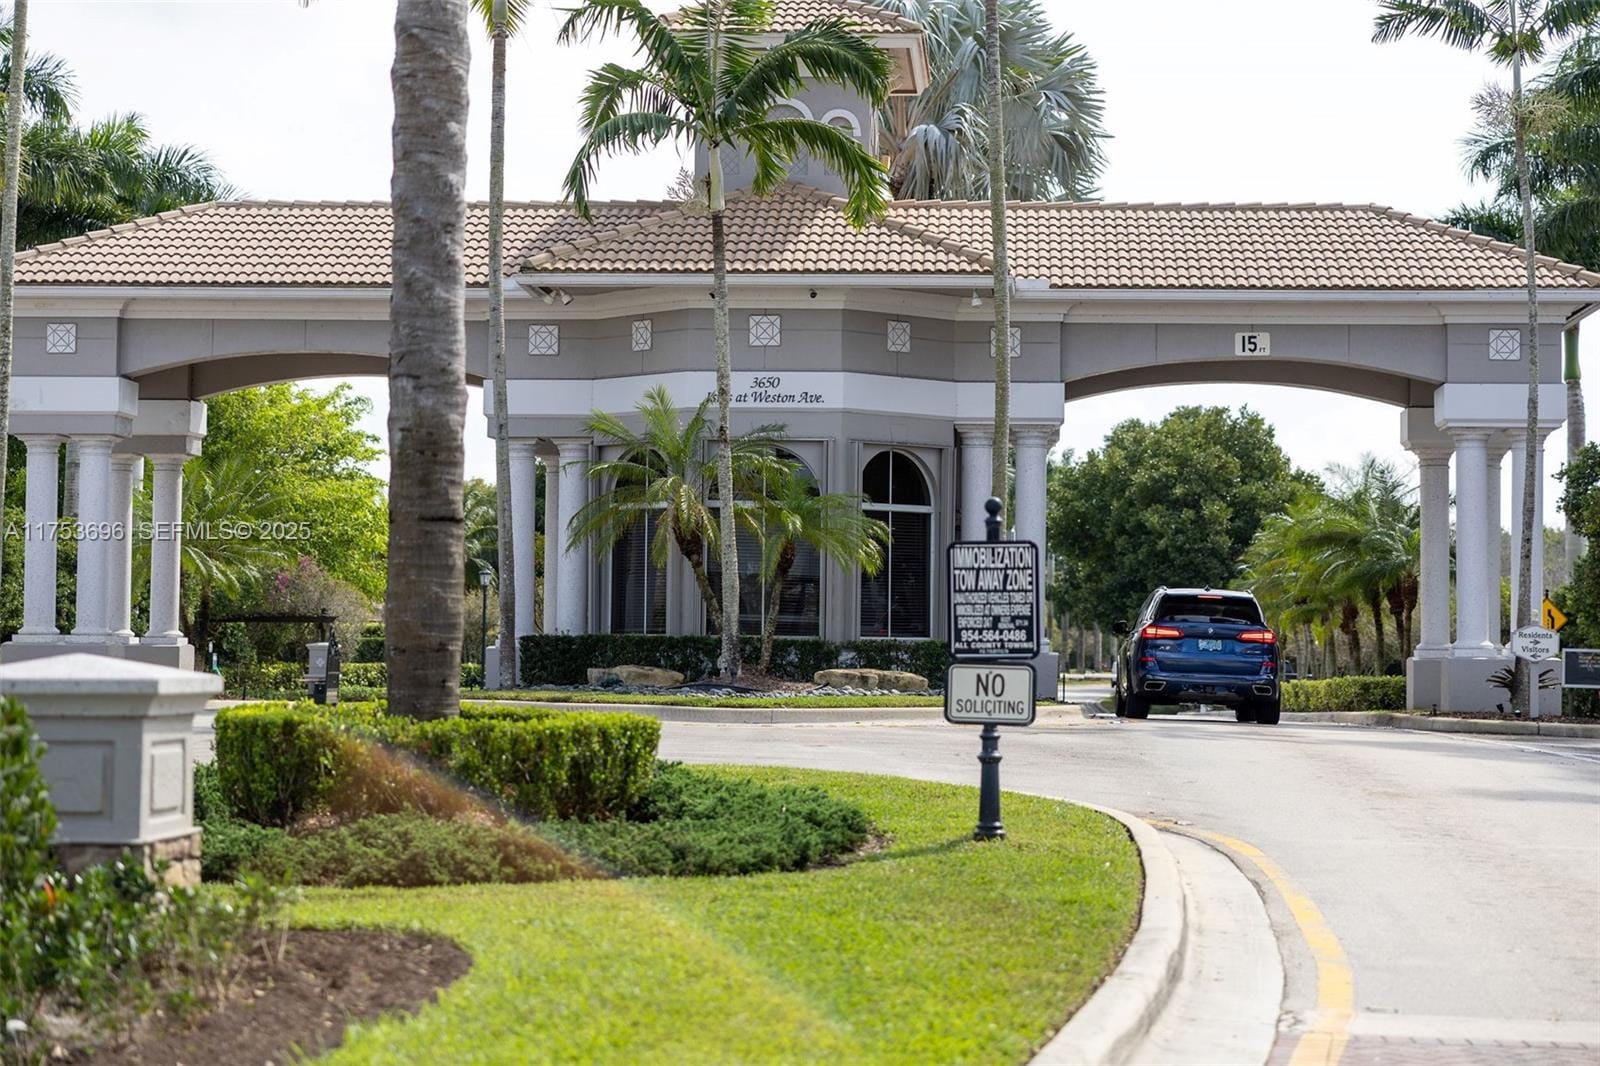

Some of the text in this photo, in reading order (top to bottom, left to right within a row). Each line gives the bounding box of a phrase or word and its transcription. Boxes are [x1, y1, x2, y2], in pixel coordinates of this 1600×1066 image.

[1242, 335, 1257, 353] 15
[750, 376, 780, 389] 3650
[735, 392, 748, 403] at
[751, 390, 795, 403] Weston
[797, 391, 824, 403] Ave.
[954, 547, 1032, 568] IMMOBILIZATION
[954, 569, 1032, 590] TOW AWAY ZONE
[961, 629, 1027, 641] 954-564-0486
[1519, 631, 1553, 639] Residents
[976, 673, 1005, 697] NO
[956, 698, 1025, 715] SOLICITING
